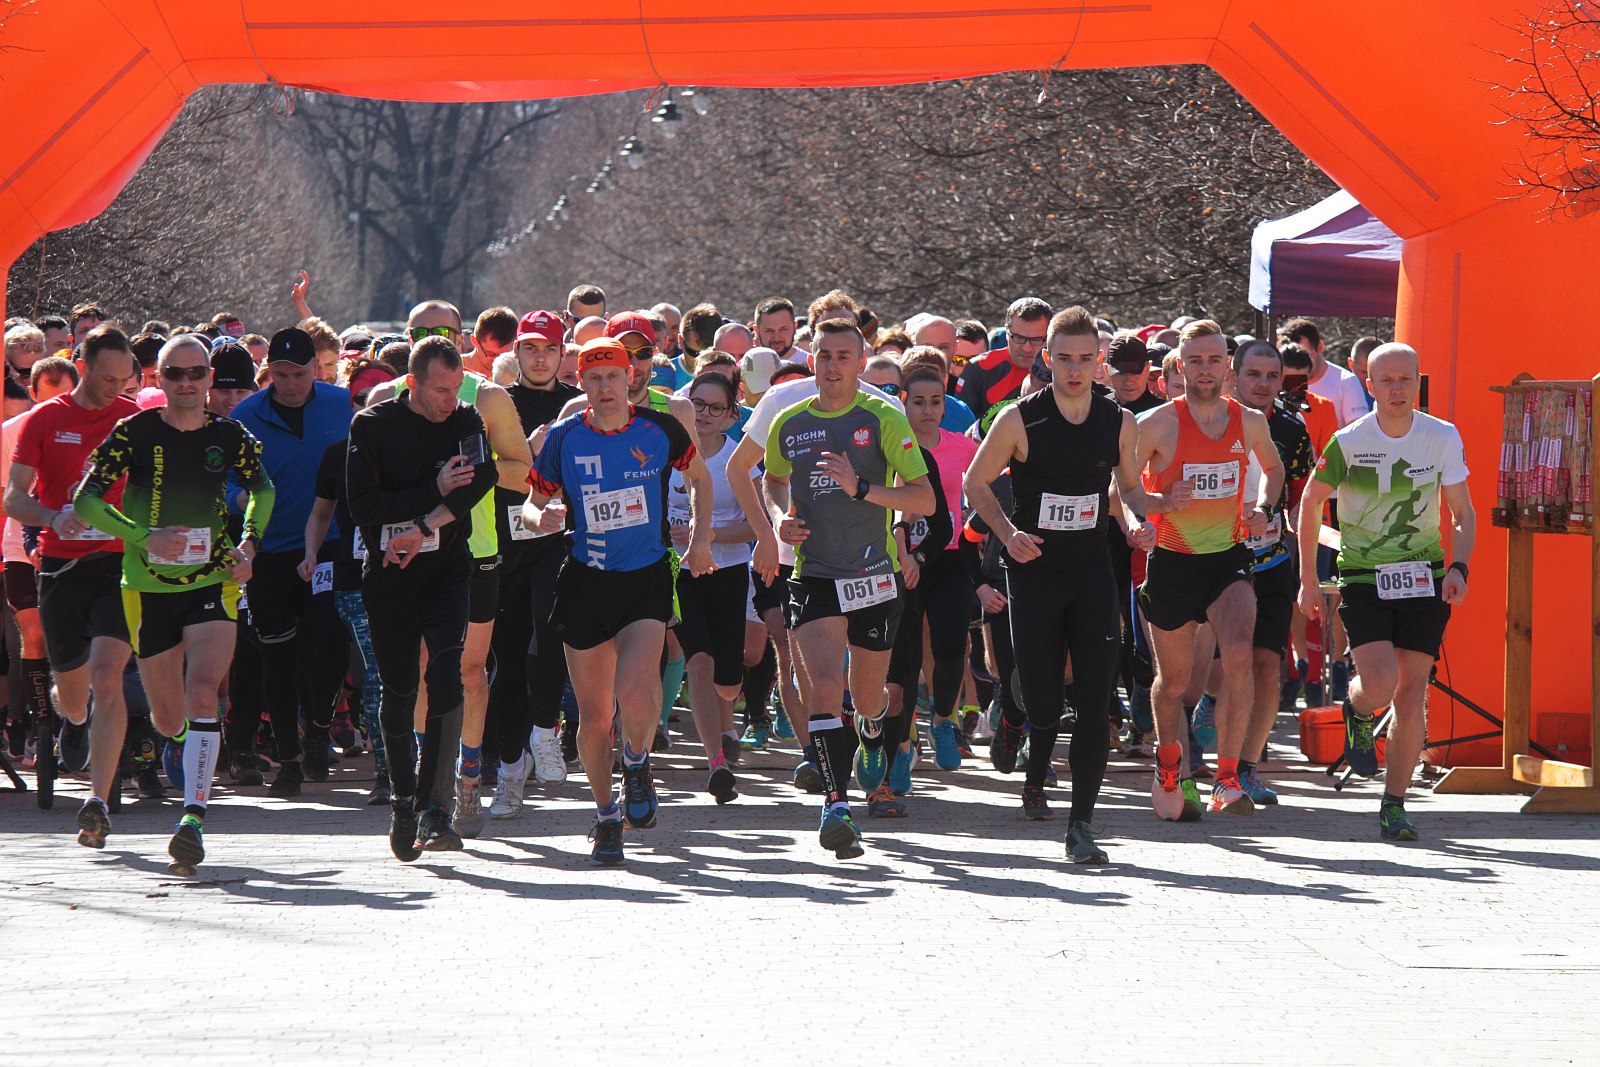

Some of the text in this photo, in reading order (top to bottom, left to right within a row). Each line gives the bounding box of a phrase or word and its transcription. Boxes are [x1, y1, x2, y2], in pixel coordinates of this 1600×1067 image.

[585, 351, 614, 363] CCC
[796, 430, 826, 442] KGHM
[590, 501, 622, 522] 192
[1048, 504, 1075, 522] 115
[843, 579, 874, 601] 051
[1381, 572, 1413, 590] 085
[29, 670, 48, 718] kalenji
